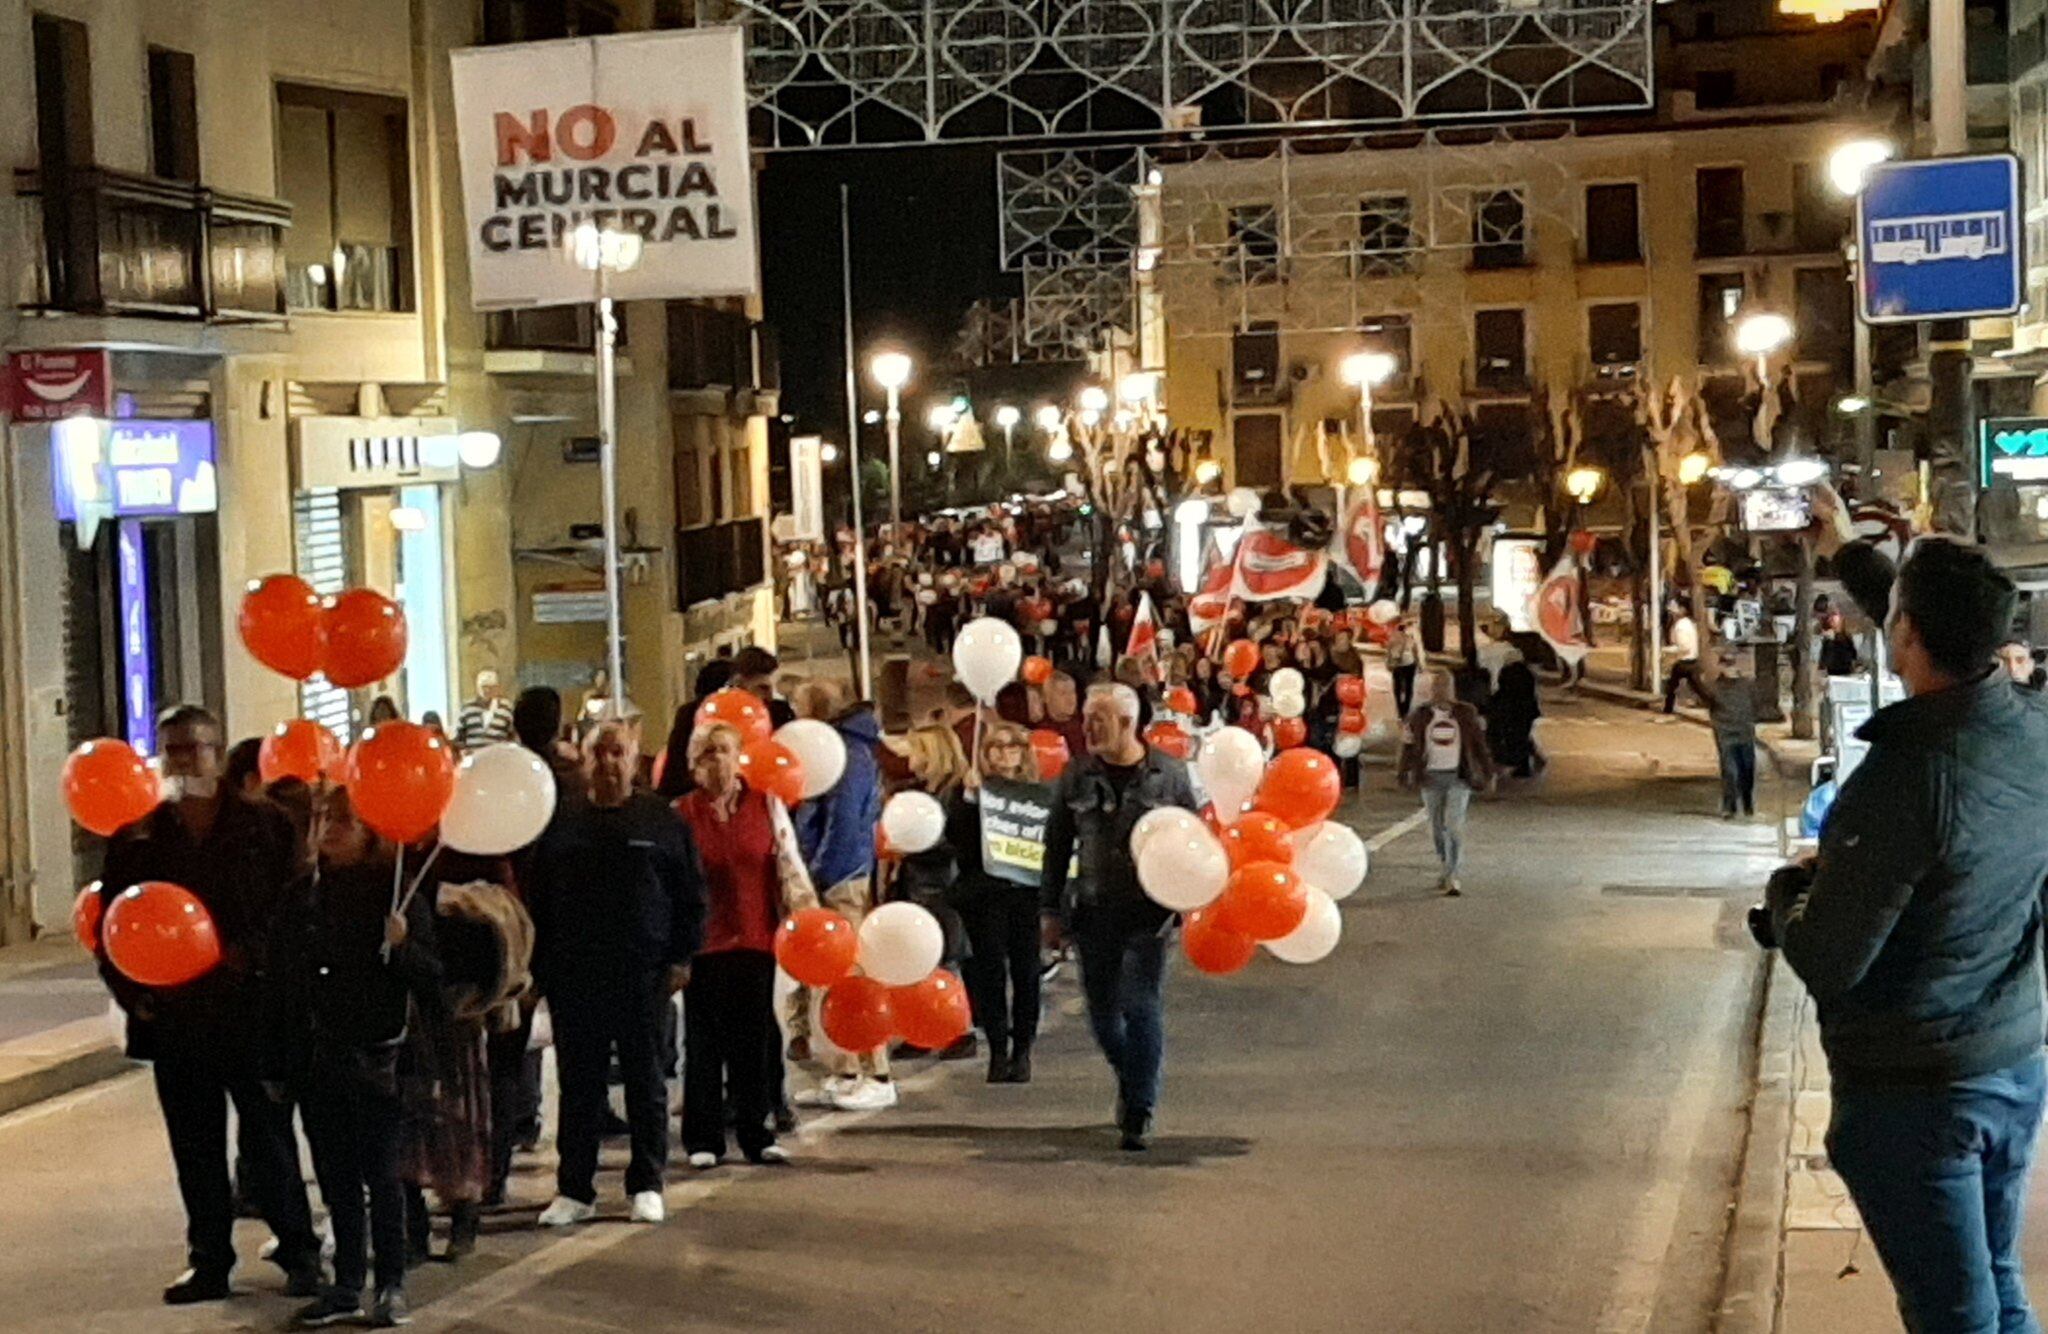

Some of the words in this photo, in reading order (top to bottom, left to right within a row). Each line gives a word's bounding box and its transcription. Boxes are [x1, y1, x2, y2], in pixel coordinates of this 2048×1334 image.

[494, 104, 616, 166] NO
[635, 117, 712, 157] AL
[494, 162, 719, 209] MURCIA
